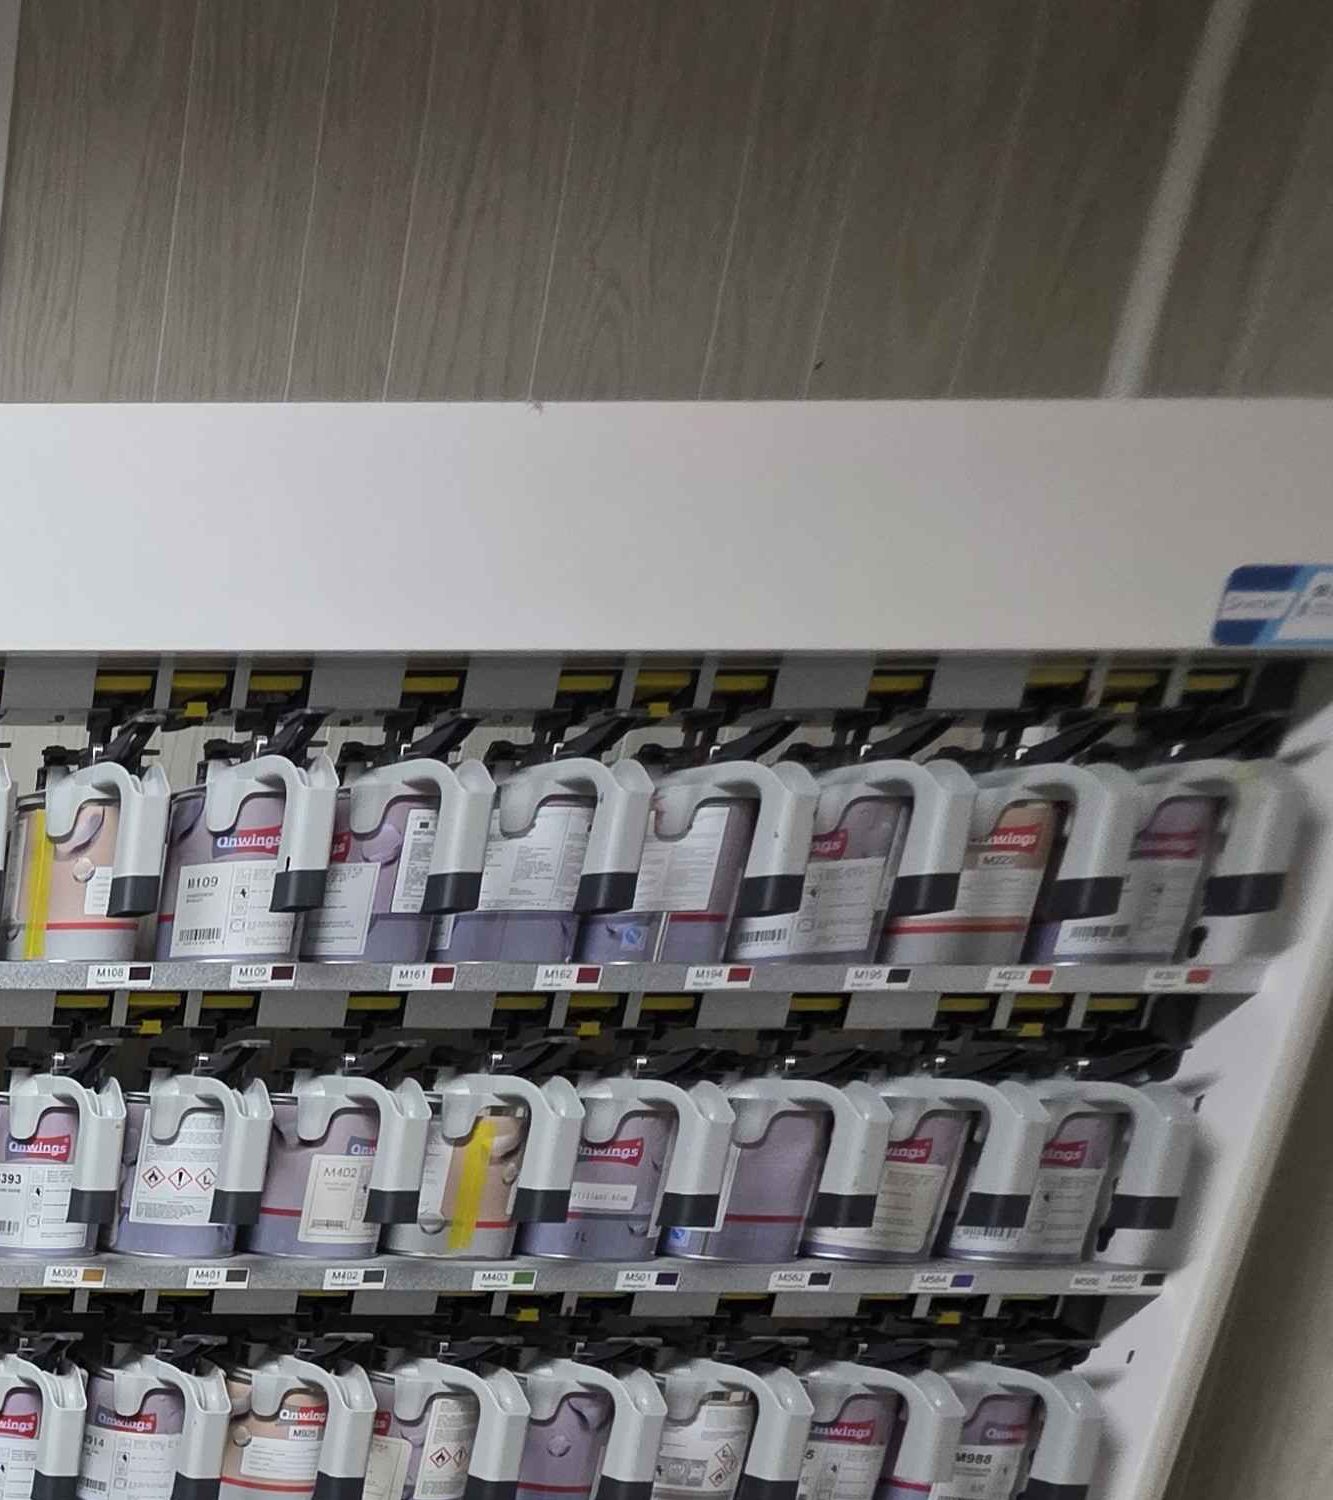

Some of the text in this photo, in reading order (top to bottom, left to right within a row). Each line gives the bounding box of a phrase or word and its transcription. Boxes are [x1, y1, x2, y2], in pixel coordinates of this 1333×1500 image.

[96, 967, 124, 978] M108
[238, 967, 267, 978] M109
[398, 970, 427, 980] M161
[543, 969, 573, 980] M162
[695, 969, 724, 979] M194
[9, 1141, 69, 1155] Onwings
[580, 1145, 639, 1159] nwings
[52, 1267, 78, 1278] M393
[195, 1269, 221, 1280] M401
[332, 1271, 359, 1281] M402
[482, 1271, 509, 1282] M403
